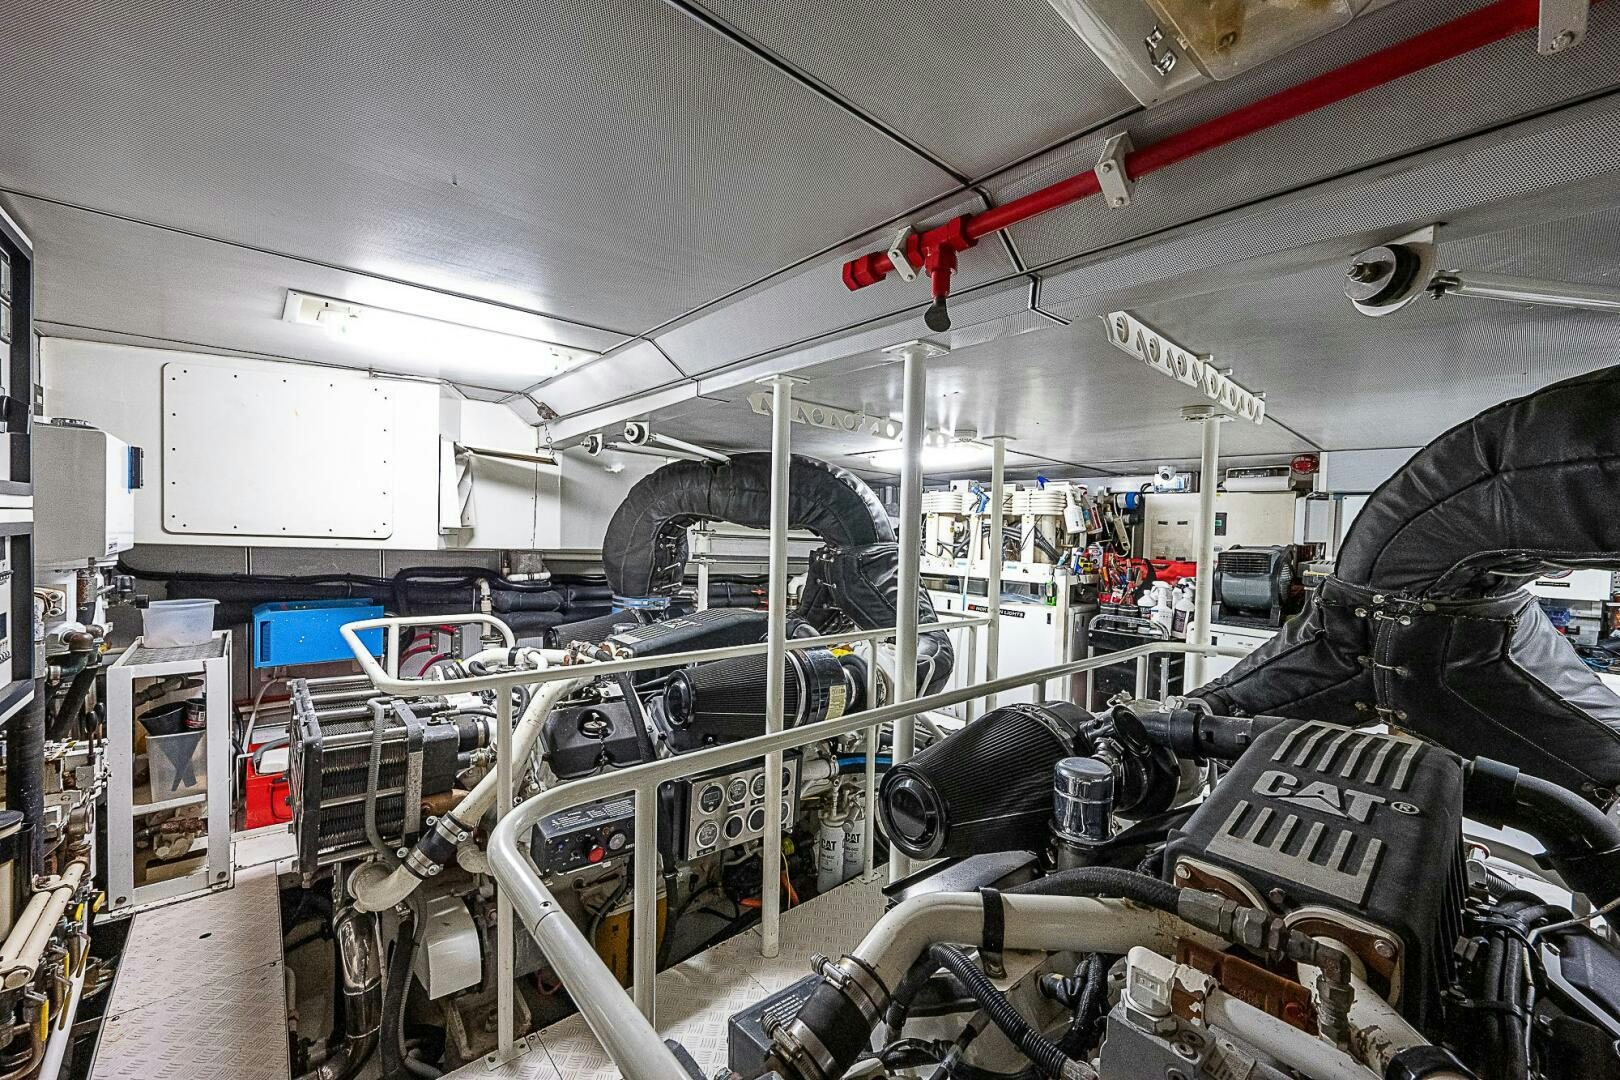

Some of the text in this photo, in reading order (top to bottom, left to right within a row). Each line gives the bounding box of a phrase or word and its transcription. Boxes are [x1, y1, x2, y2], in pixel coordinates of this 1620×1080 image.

[1004, 609, 1024, 617] LIGHTS
[1252, 770, 1386, 823] CAT
[845, 832, 861, 843] CAT
[821, 838, 837, 851] CAT
